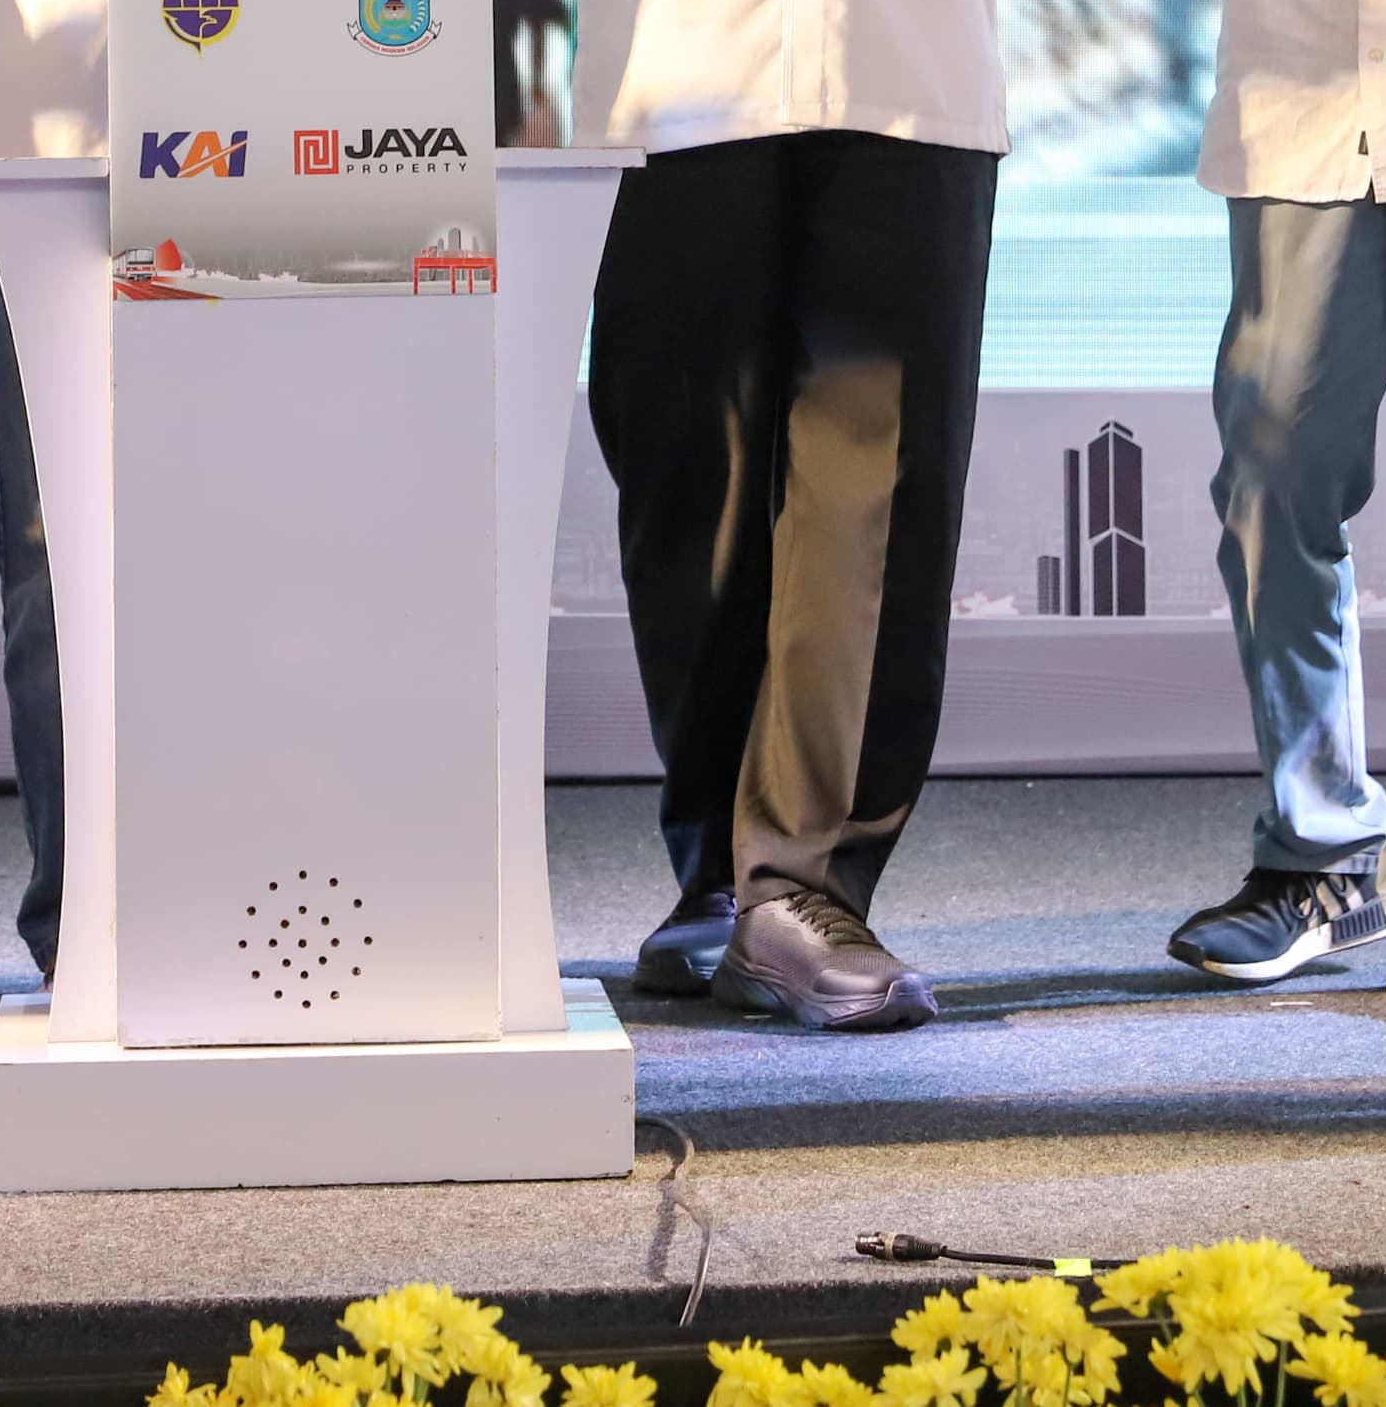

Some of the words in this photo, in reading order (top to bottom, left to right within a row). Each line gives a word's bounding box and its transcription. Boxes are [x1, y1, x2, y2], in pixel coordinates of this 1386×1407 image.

[139, 130, 248, 179] KAI
[344, 127, 468, 159] JAYA
[346, 162, 468, 174] PROPERTY
